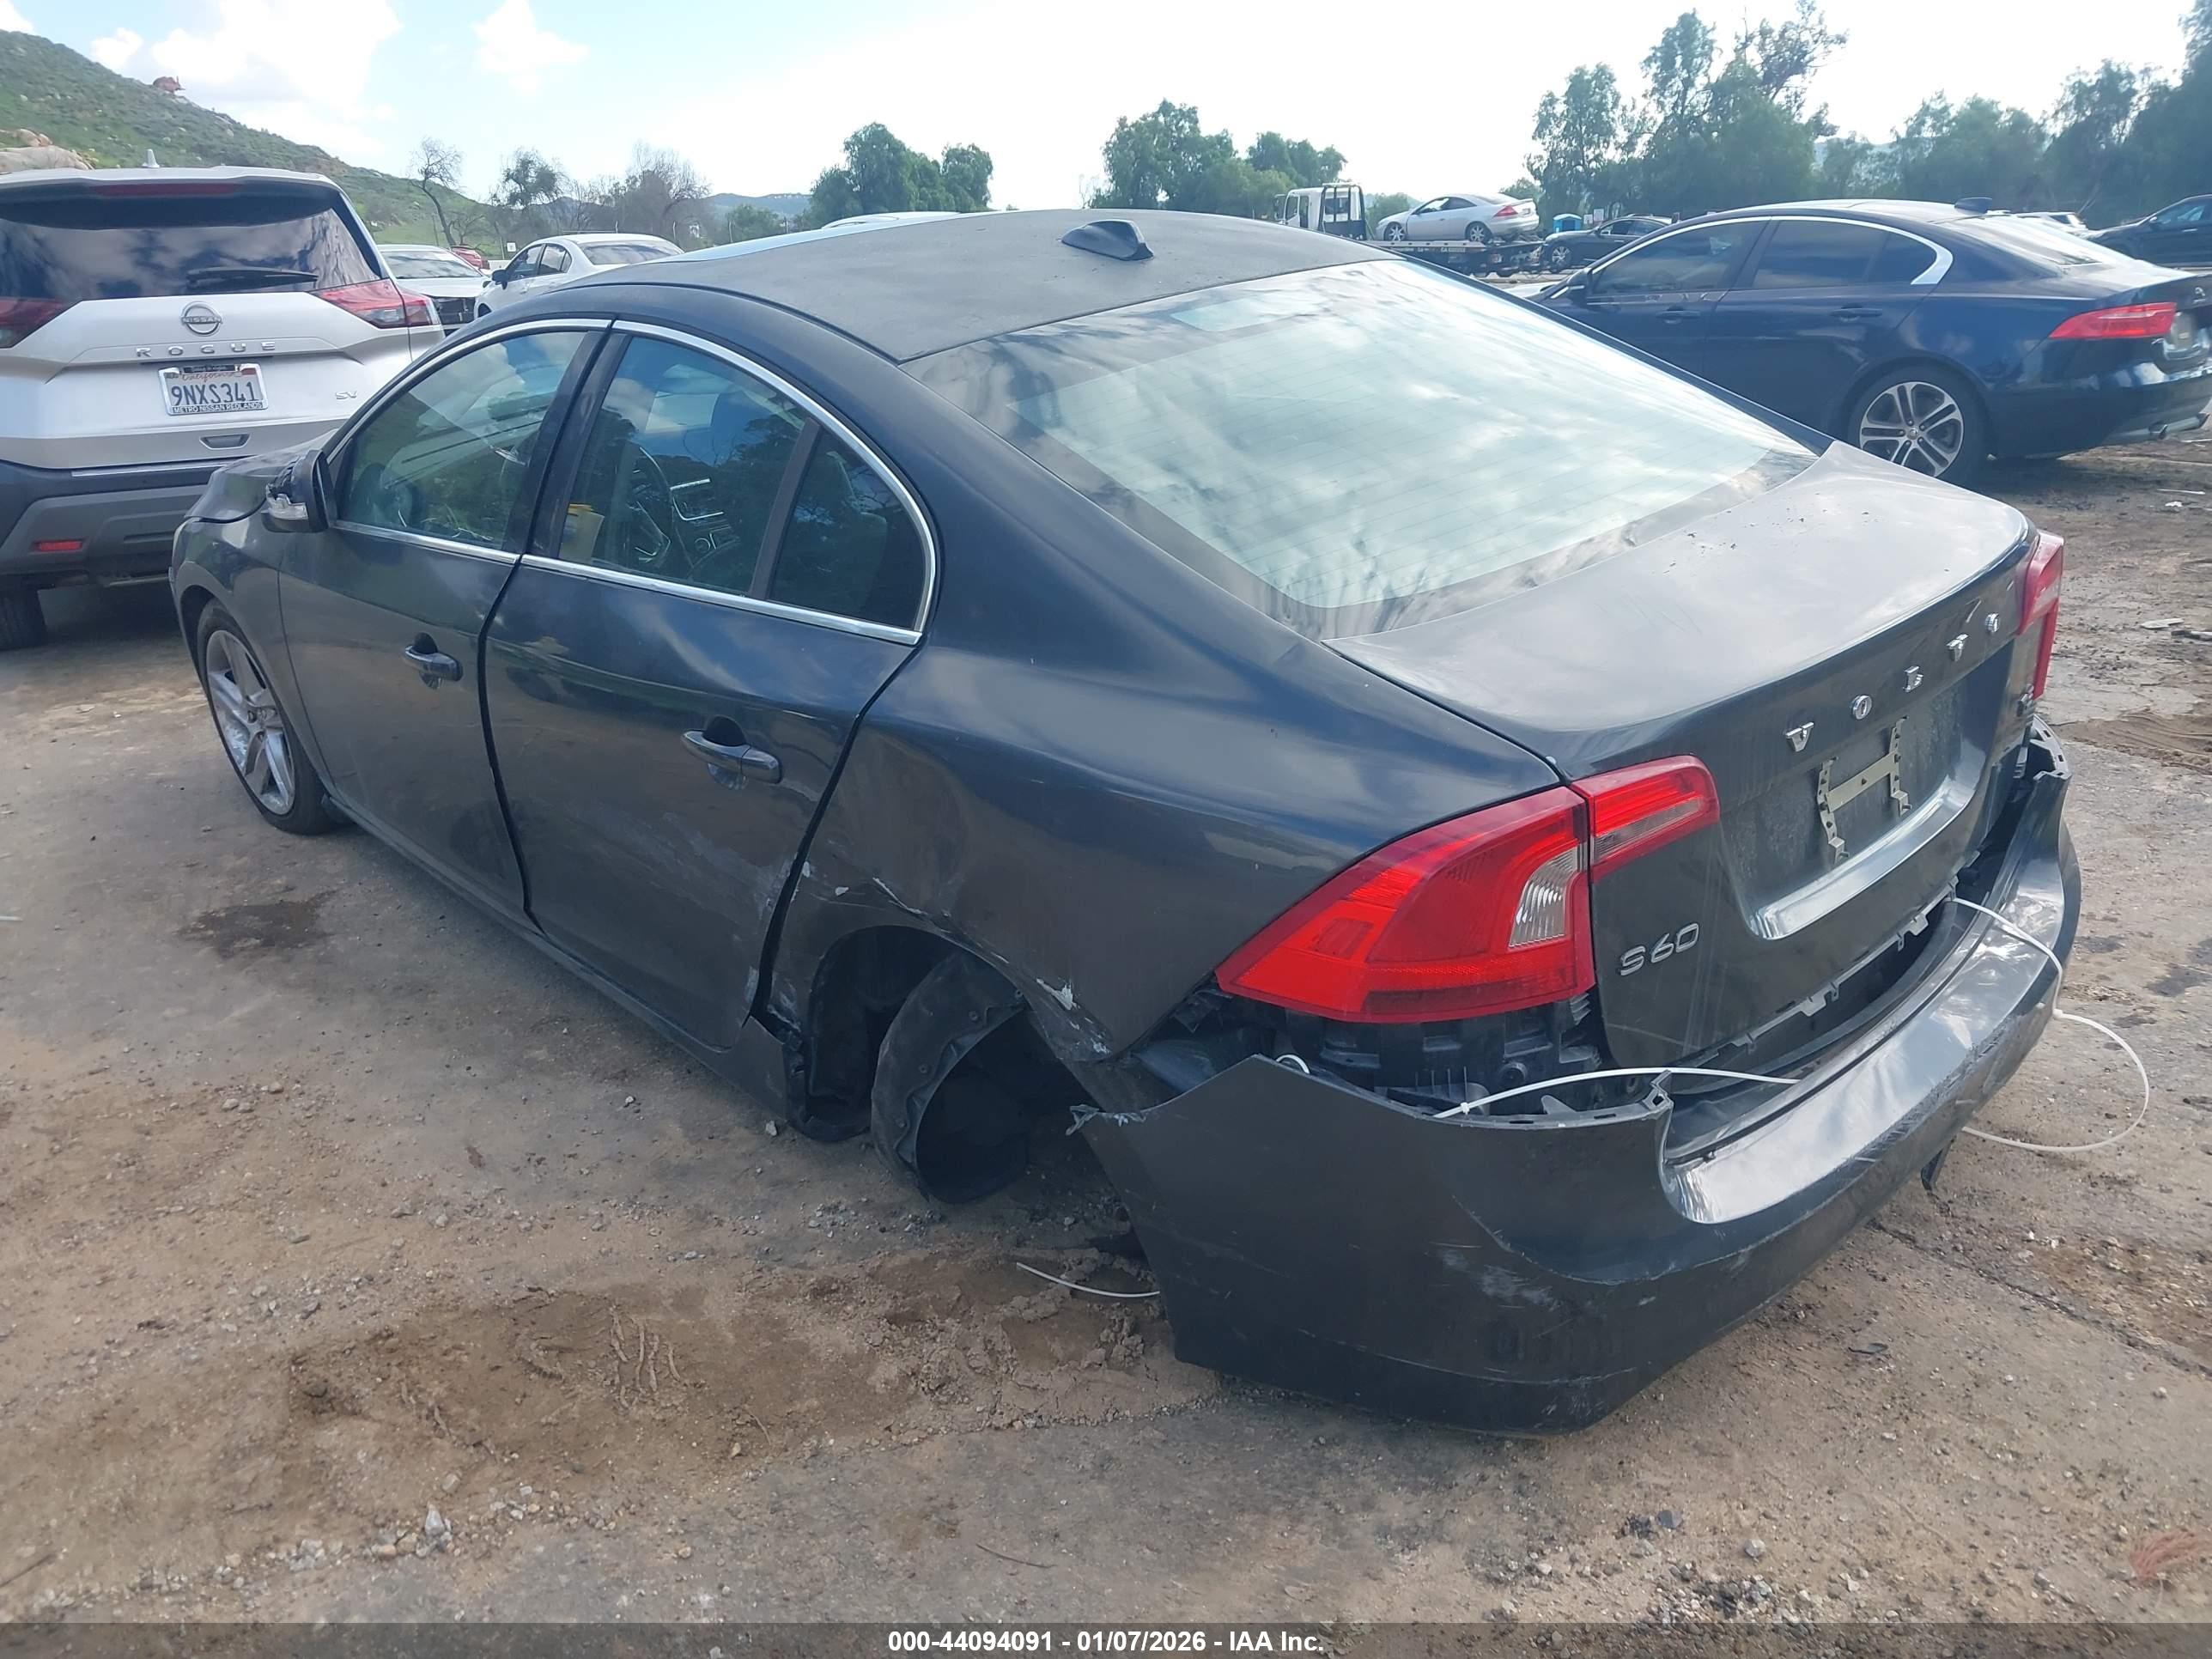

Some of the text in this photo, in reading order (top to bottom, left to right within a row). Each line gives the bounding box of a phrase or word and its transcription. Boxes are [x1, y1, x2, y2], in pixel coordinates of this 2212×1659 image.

[181, 316, 222, 325] NISSAN
[136, 342, 276, 357] ROGUE
[171, 381, 261, 406] 9NXS341
[335, 390, 358, 401] SV
[199, 404, 225, 412] NISSAN
[1784, 612, 2001, 752] VOLVO
[1620, 922, 1699, 976] S60
